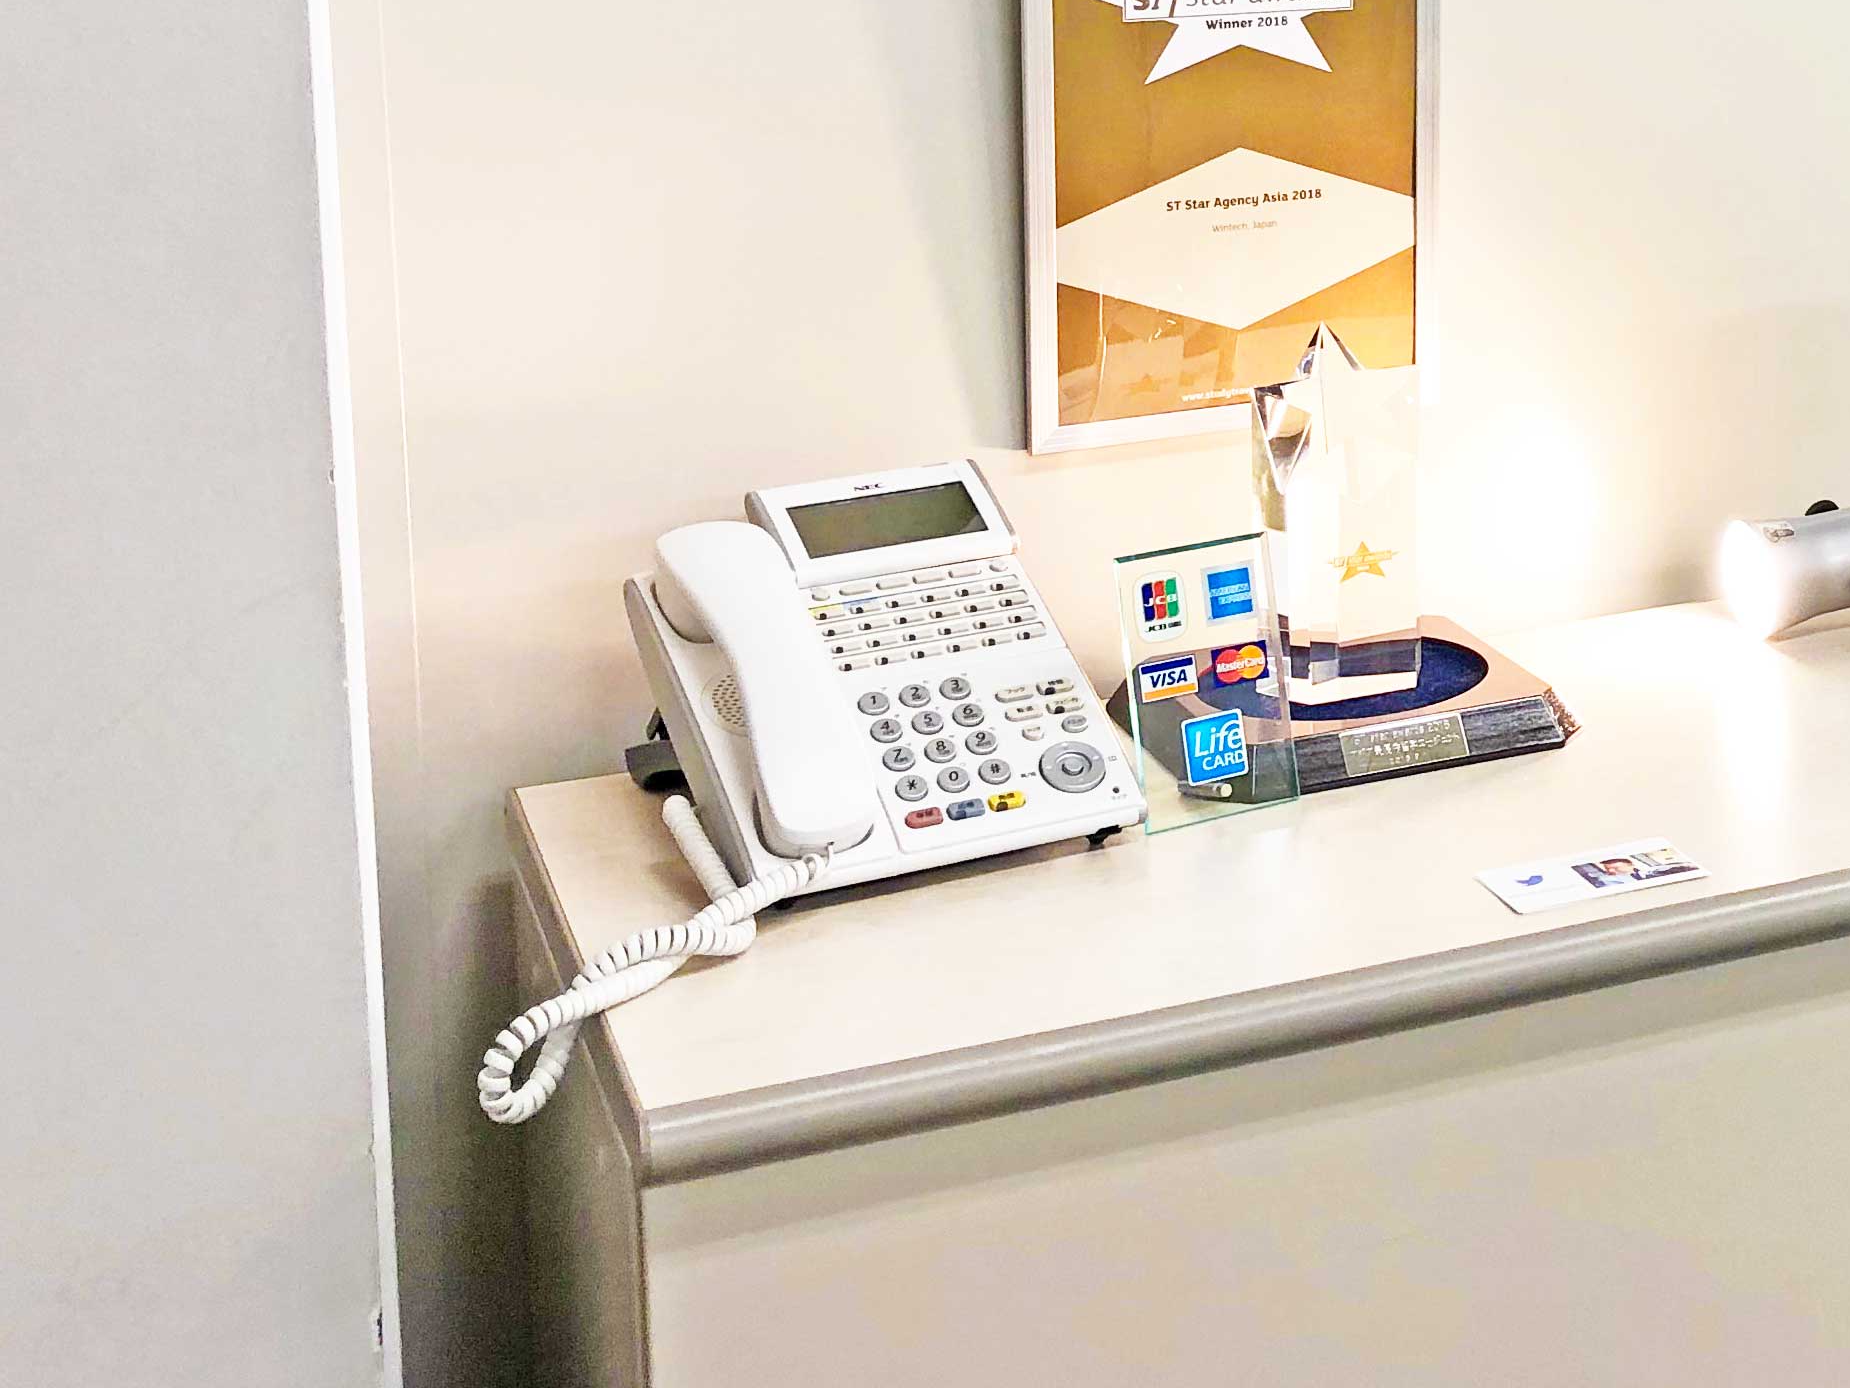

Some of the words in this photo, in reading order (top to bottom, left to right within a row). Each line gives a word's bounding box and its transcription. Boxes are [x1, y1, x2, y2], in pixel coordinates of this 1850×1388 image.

[1205, 18, 1252, 30] Winner
[1257, 16, 1288, 28] 2018
[1166, 200, 1182, 212] ST
[1185, 199, 1210, 210] Star
[1214, 195, 1259, 209] Agency
[1262, 191, 1289, 203] Asia
[1292, 188, 1322, 200] 2018
[1144, 593, 1178, 607] JCB
[1216, 656, 1265, 673] MasterCard
[1150, 669, 1188, 688] VISA
[1194, 719, 1242, 758] Life
[1202, 749, 1245, 771] CARD
